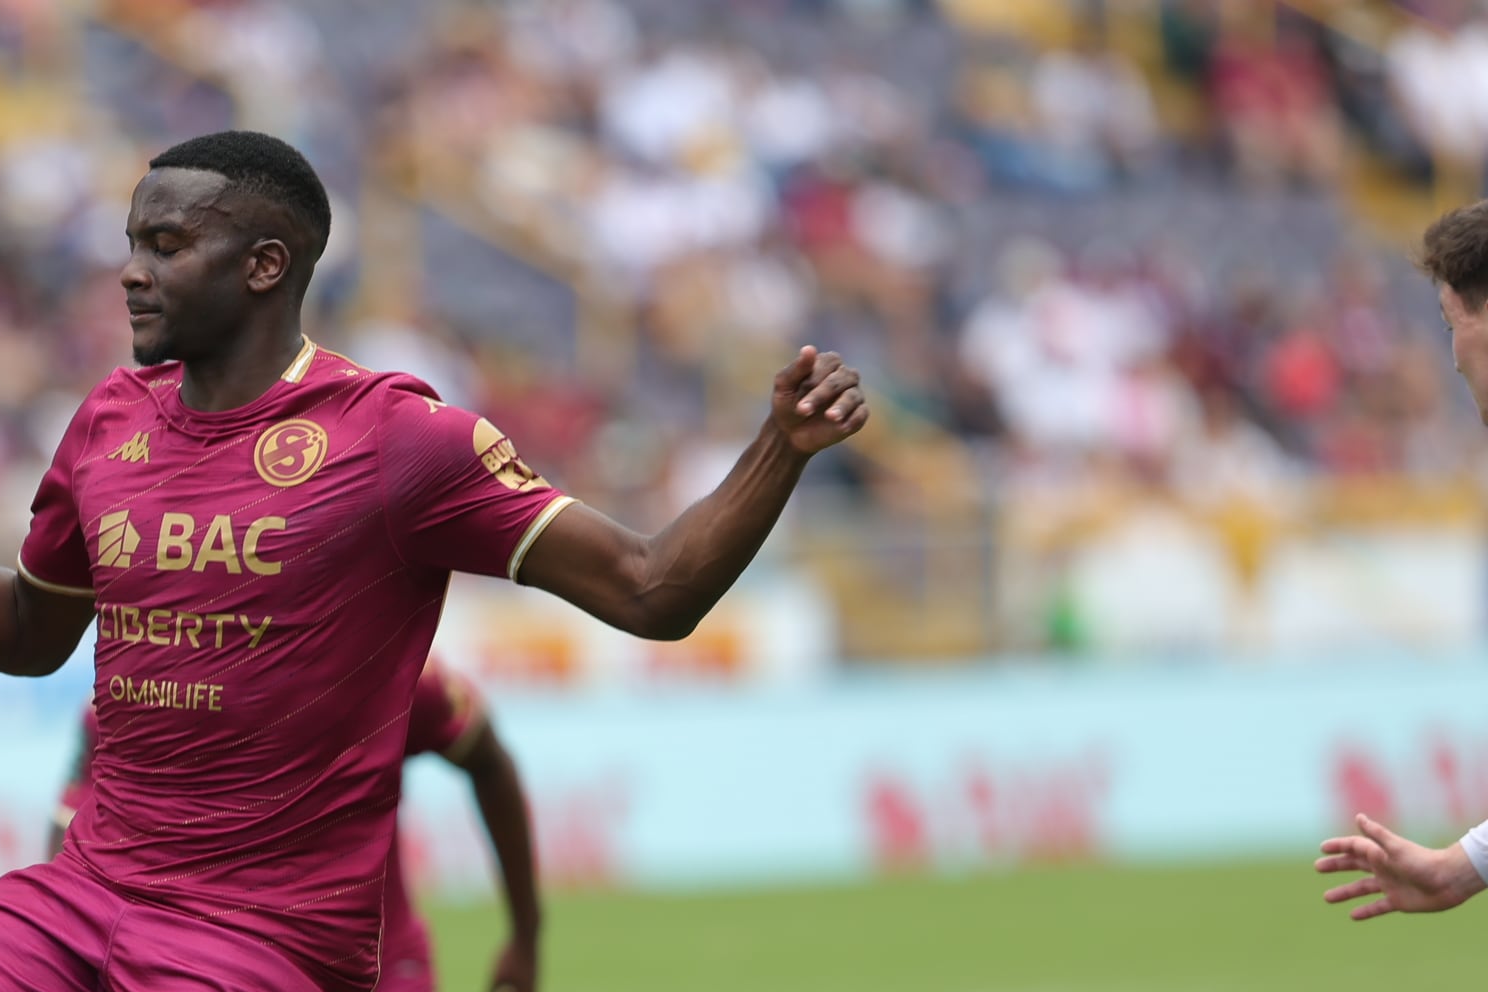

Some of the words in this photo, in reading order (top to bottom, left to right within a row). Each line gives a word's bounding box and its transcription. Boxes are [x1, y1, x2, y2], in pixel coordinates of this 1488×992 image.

[156, 512, 287, 576] BAC
[100, 603, 273, 648] LIBERTY
[109, 674, 223, 711] OMNILIFE
